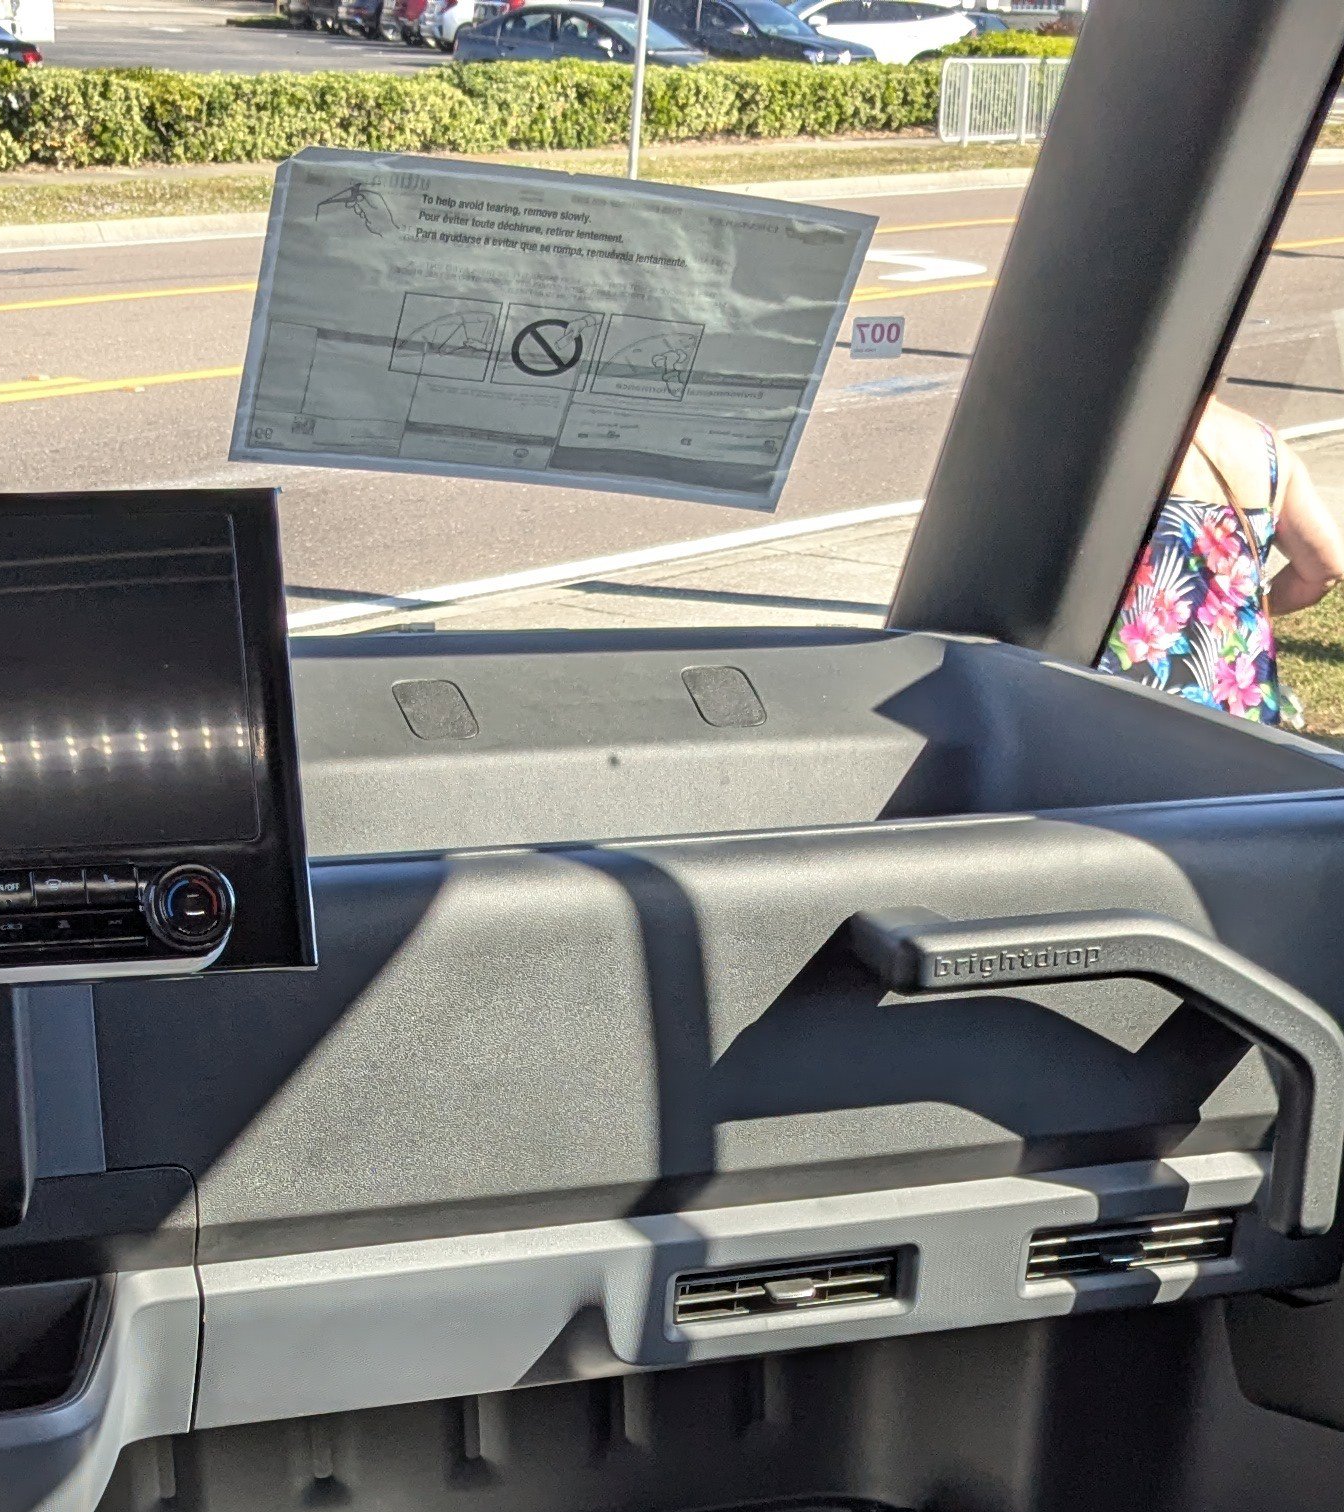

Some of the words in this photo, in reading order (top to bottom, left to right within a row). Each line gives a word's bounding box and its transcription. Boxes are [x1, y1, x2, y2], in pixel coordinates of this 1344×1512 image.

[418, 210, 440, 222] Pour
[471, 216, 495, 229] toute
[545, 227, 575, 238] retirer
[422, 193, 434, 205] To
[436, 195, 457, 209] help
[458, 199, 485, 212] avoid
[523, 207, 558, 220] remove
[559, 210, 592, 225] slowly.
[416, 227, 438, 240] Para
[439, 231, 482, 245] ayudarse
[483, 237, 490, 246] a
[491, 237, 519, 249] evitar
[520, 240, 537, 252] que
[539, 243, 551, 253] se
[933, 946, 1101, 978] brightdrop
